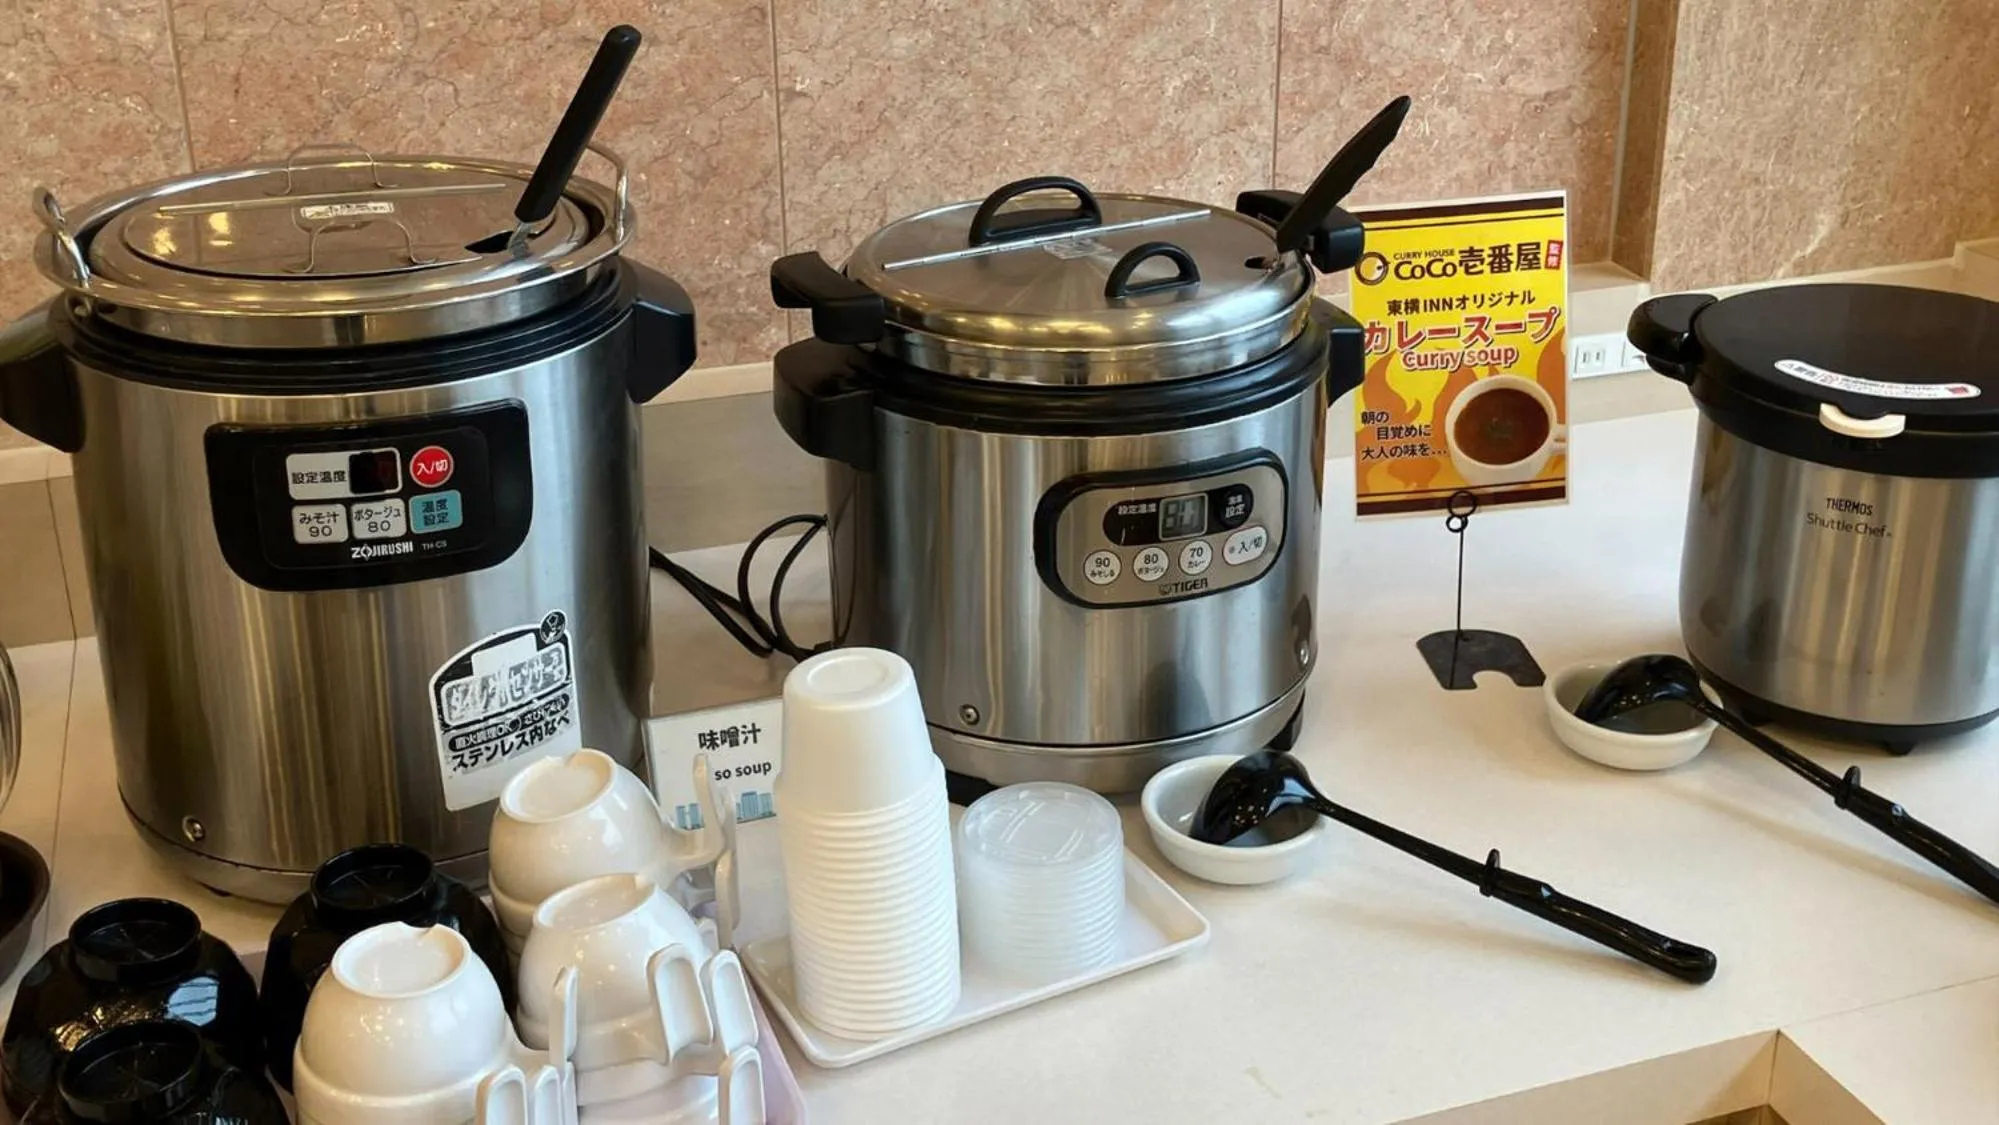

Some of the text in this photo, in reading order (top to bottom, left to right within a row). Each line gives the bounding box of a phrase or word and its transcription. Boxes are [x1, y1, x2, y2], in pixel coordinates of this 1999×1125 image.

[1393, 248, 1455, 260] CURRY HOUSE
[1387, 289, 1536, 316] 東横INNオリジナル
[1364, 306, 1560, 354] カレースープ
[1402, 346, 1518, 371] Curry soup
[1361, 411, 1389, 425] 朝の
[1376, 424, 1432, 440] 目覚めに
[417, 459, 449, 476] 入/切
[291, 470, 347, 485] 設定温度
[422, 498, 448, 513] 温度
[1826, 498, 1873, 516] THERMOS
[299, 511, 340, 524] みそ汁
[354, 506, 402, 521] ポタージュ
[423, 512, 449, 526] 設定
[368, 520, 391, 533] 80
[1806, 512, 1853, 532] Shuttle
[309, 525, 332, 537] 90
[351, 541, 413, 560] ZOJIRUSHI
[1189, 547, 1204, 558] 70
[1095, 556, 1111, 568] 90
[1144, 553, 1159, 565] 80
[1174, 578, 1209, 593] TIGER
[451, 712, 570, 772] ステンレス内なべ
[698, 722, 762, 750] 味噌汁
[714, 761, 772, 781] so soup
